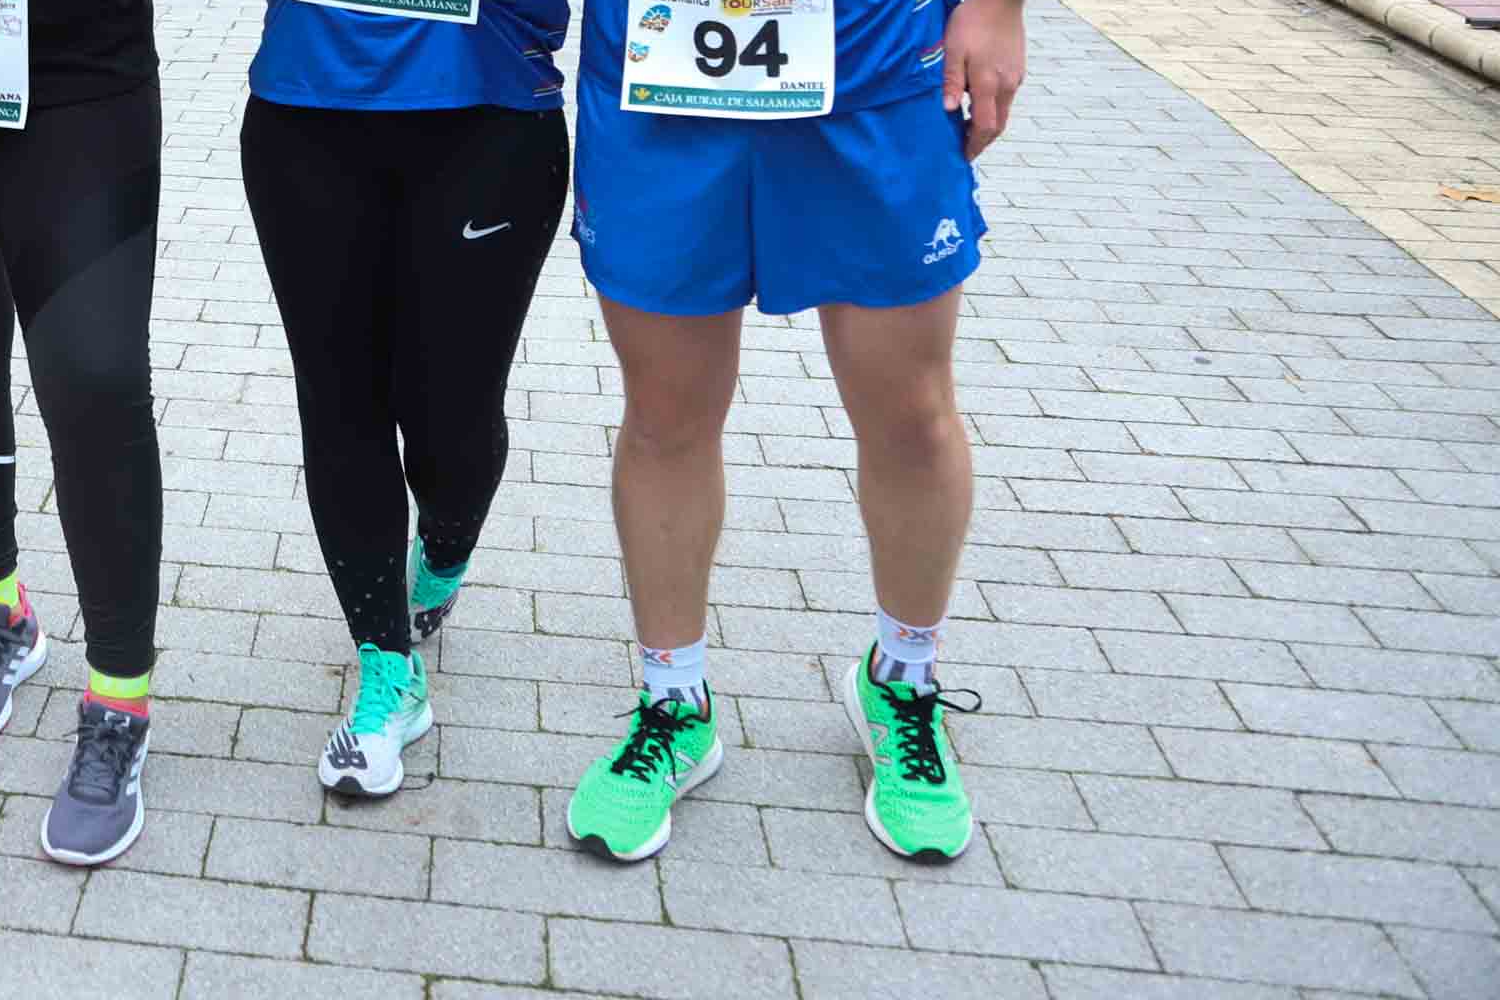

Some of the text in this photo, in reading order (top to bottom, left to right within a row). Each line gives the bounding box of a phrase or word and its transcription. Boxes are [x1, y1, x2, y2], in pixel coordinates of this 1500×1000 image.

[693, 19, 789, 78] 94
[780, 81, 826, 90] DANIEL
[654, 92, 821, 108] CAJA RURAL DE SALAMANCA
